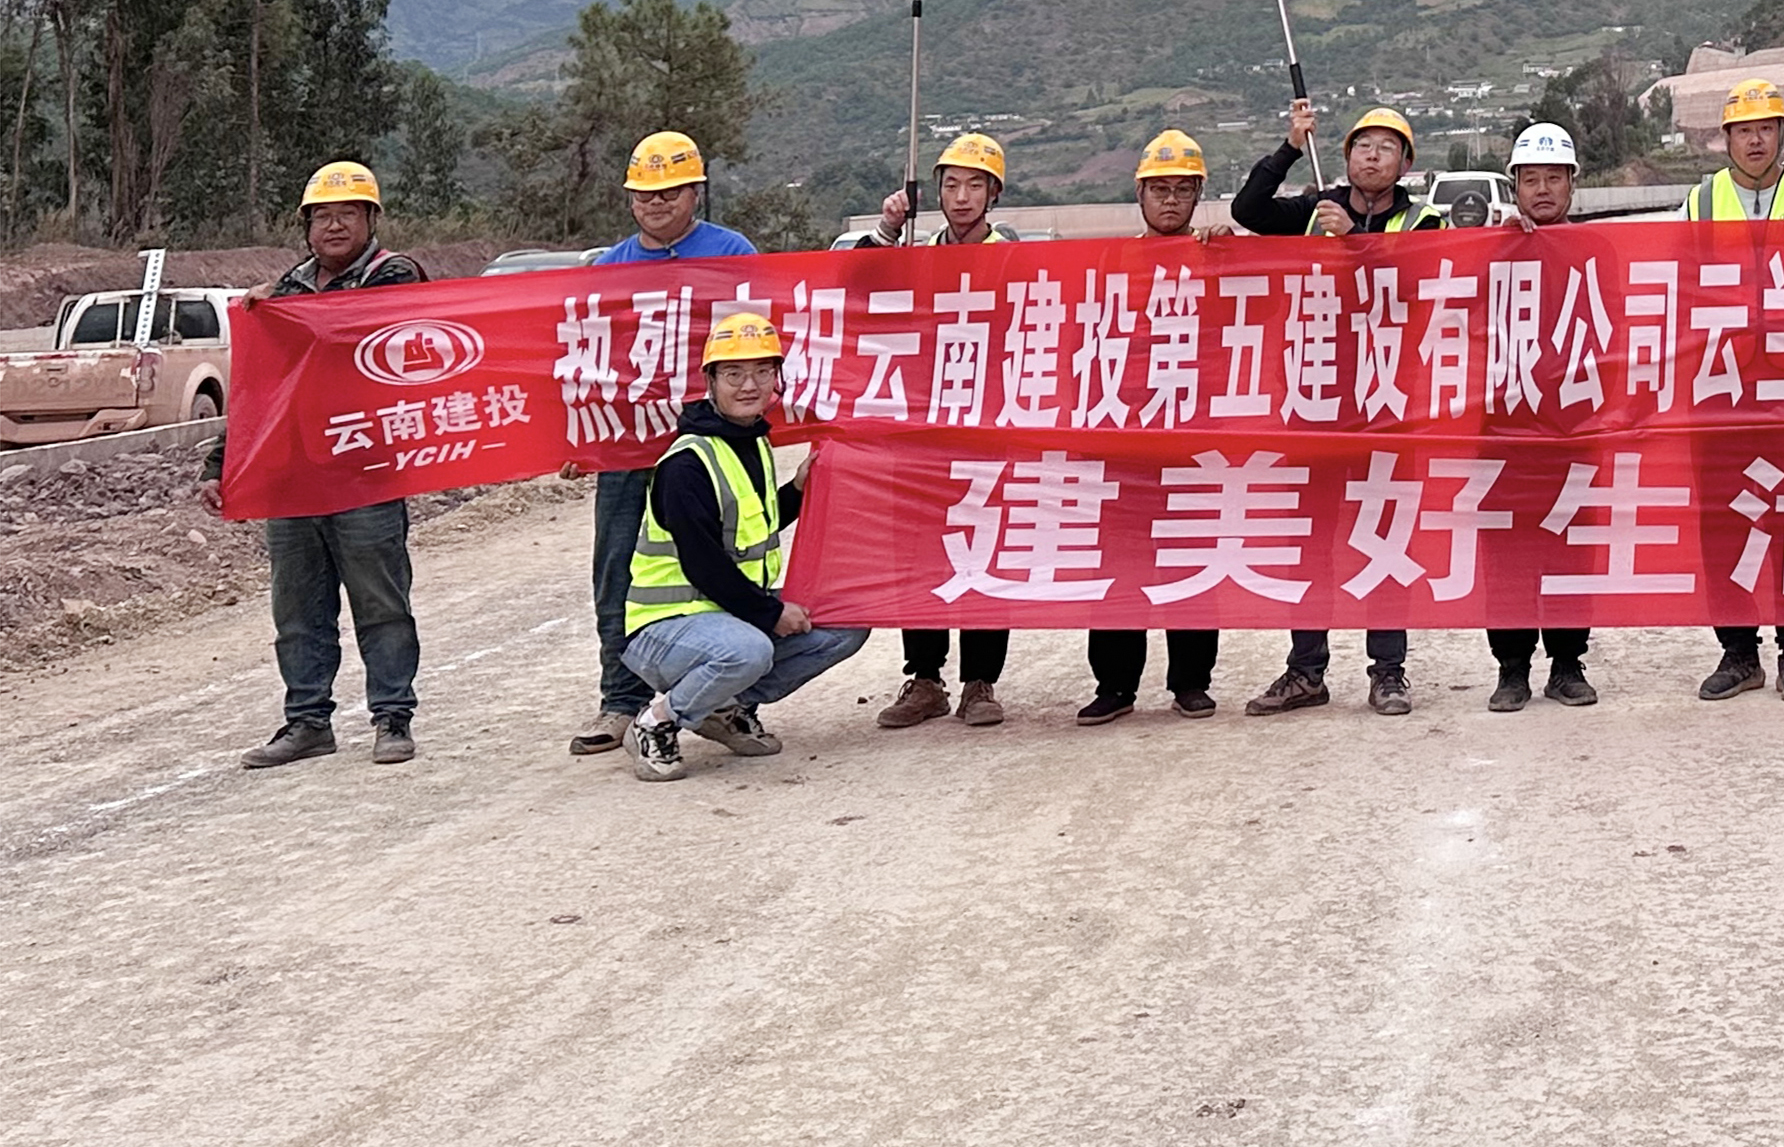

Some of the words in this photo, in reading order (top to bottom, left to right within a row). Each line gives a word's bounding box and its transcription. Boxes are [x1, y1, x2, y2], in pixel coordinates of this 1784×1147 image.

[324, 384, 531, 456] 云南建投
[395, 439, 477, 471] YCIH
